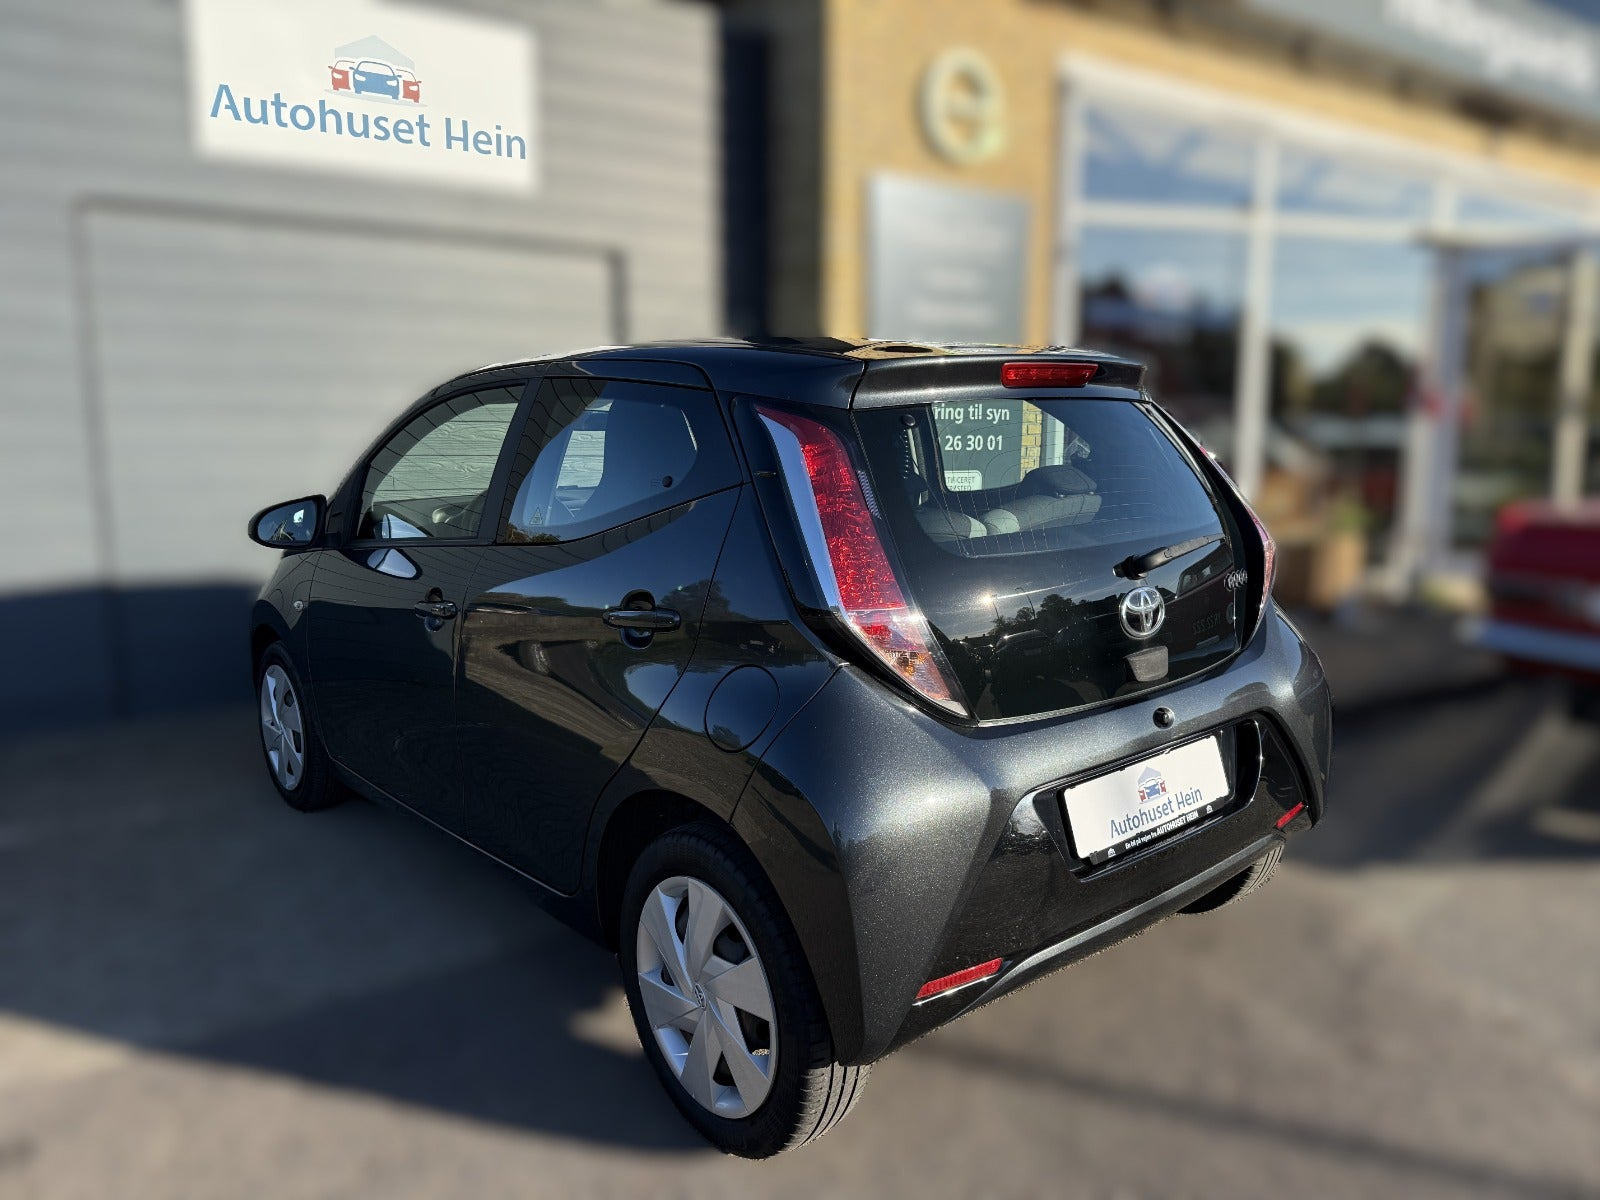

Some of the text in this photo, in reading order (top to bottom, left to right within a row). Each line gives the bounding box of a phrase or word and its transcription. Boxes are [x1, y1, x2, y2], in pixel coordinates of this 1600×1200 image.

[210, 83, 527, 160] Autohuset Hein
[932, 402, 1010, 425] ring til syn
[944, 434, 1003, 451] 26 30 01
[1110, 787, 1203, 838] Autohuset Hein
[1156, 816, 1187, 835] AUTOHUSET
